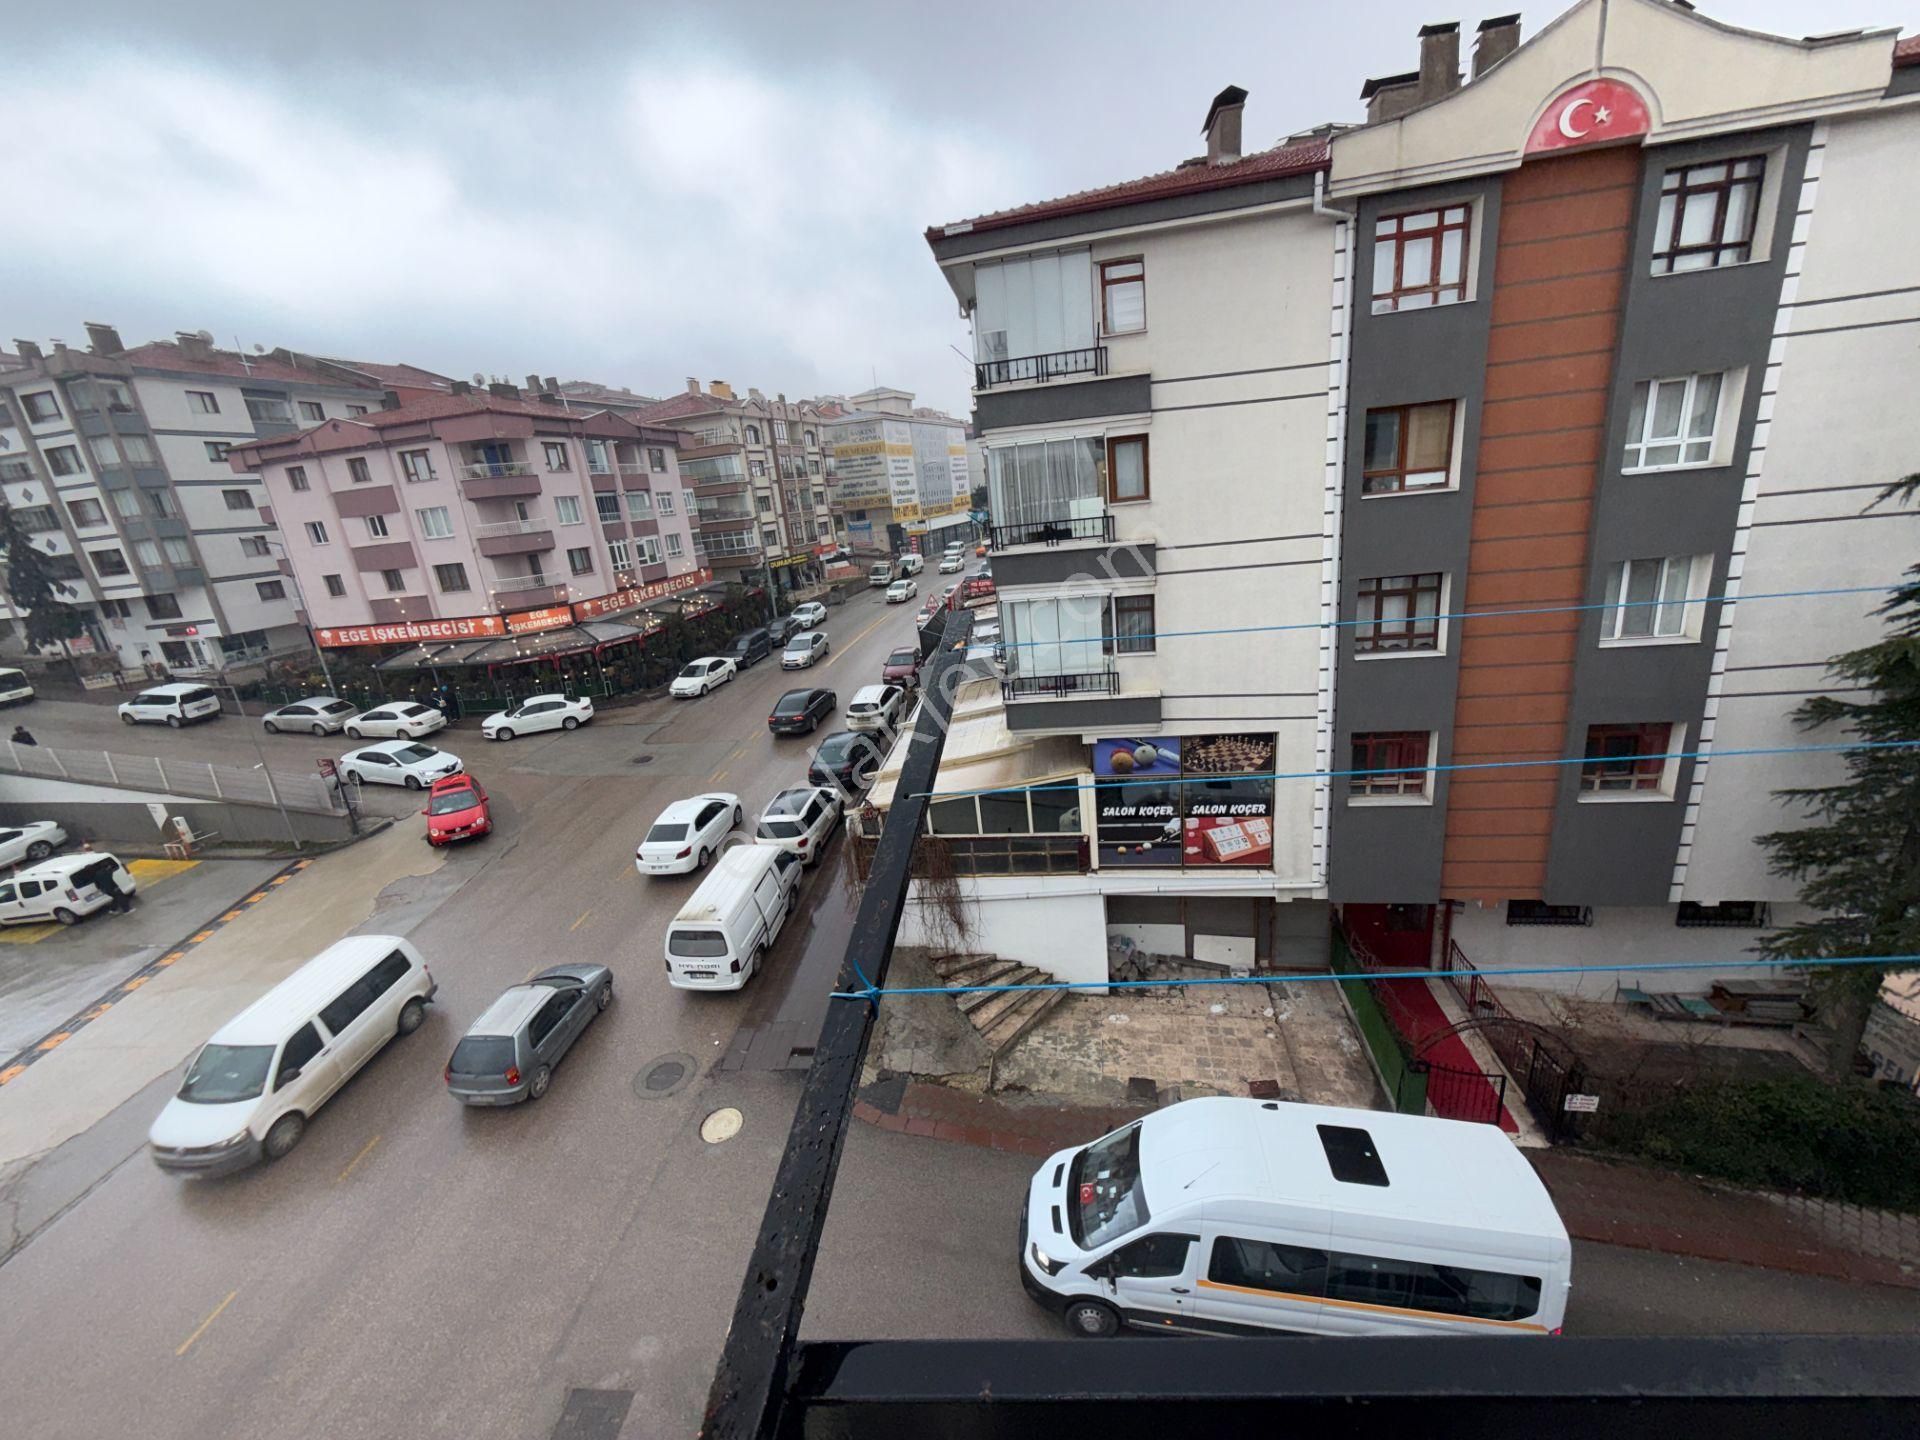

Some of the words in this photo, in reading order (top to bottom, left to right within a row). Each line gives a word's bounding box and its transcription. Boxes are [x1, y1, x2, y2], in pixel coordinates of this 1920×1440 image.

[601, 594, 626, 611] EGE
[529, 610, 549, 620] EGE
[339, 630, 370, 643] EGE
[1102, 806, 1136, 817] SALON
[1138, 805, 1174, 818] KOÇER
[1191, 804, 1227, 815] SALON
[1229, 803, 1267, 816] KOÇER
